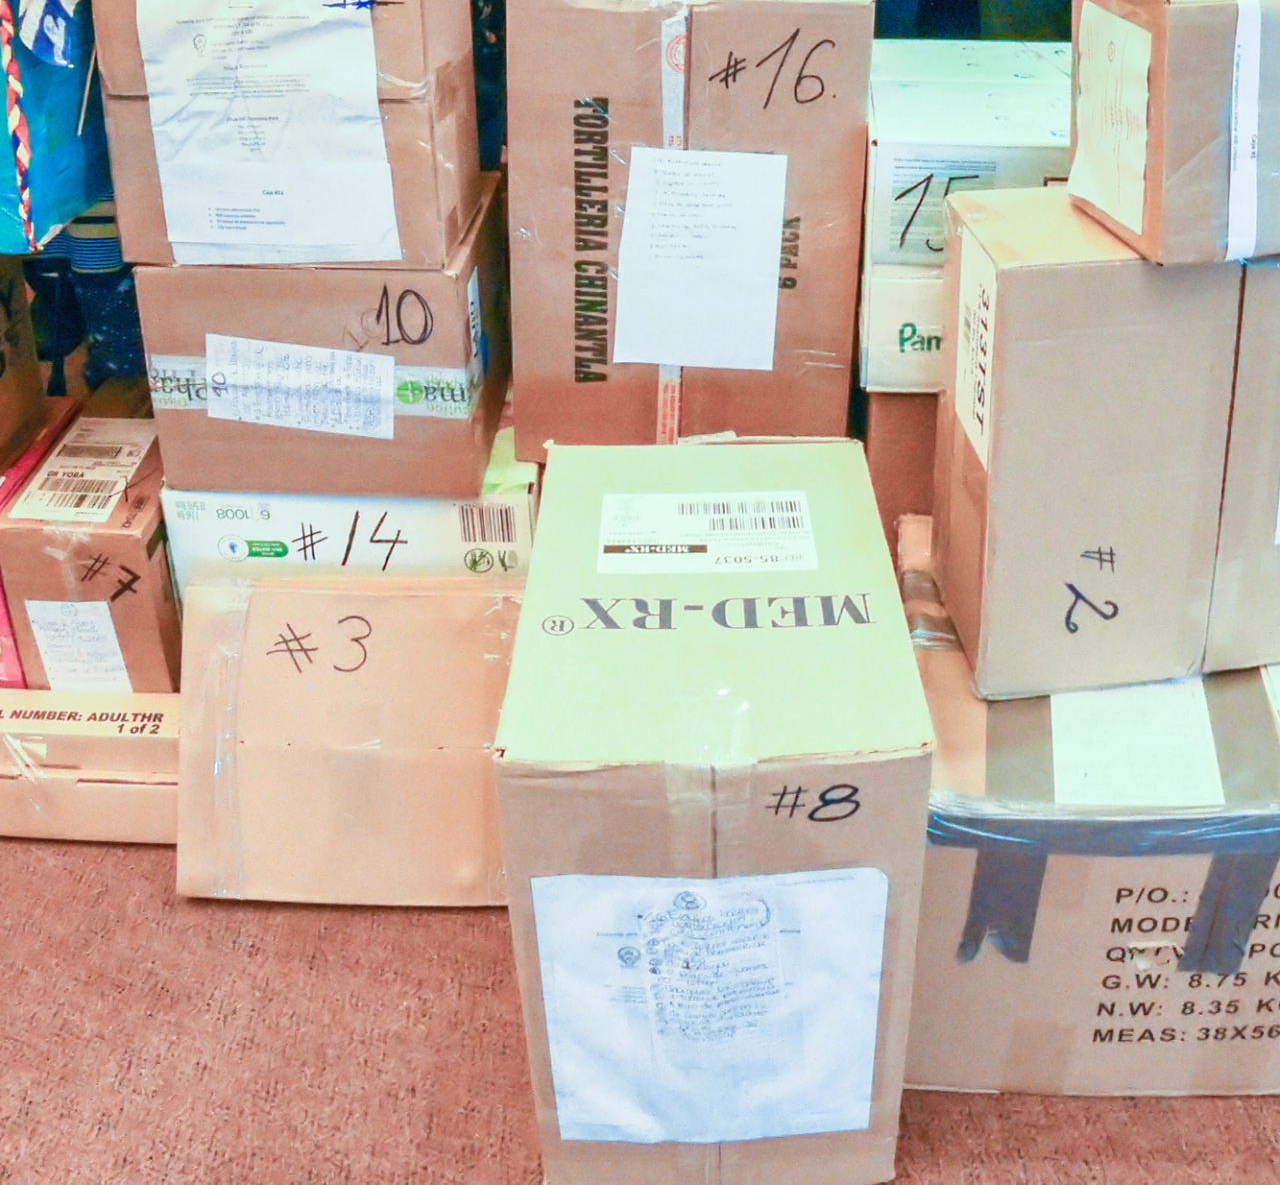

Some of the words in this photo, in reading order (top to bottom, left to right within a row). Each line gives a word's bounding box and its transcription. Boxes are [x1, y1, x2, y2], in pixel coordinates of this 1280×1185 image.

[573, 96, 610, 253] TORTILLERIA
[376, 283, 434, 347] 10
[573, 259, 610, 384] CHINANTLA
[975, 287, 992, 437] 313TST
[712, 553, 780, 565] 85-5037
[8, 709, 83, 722] NUMBER:
[85, 711, 166, 724] ADULTHR
[116, 723, 125, 735] 1
[129, 722, 149, 736] of
[148, 723, 161, 735] 2
[1101, 973, 1171, 990] G.W:
[1187, 971, 1249, 990] 8.75
[1096, 1000, 1164, 1017] N.W:
[1180, 999, 1241, 1016] 8.35
[1091, 1027, 1187, 1043] MEAS:
